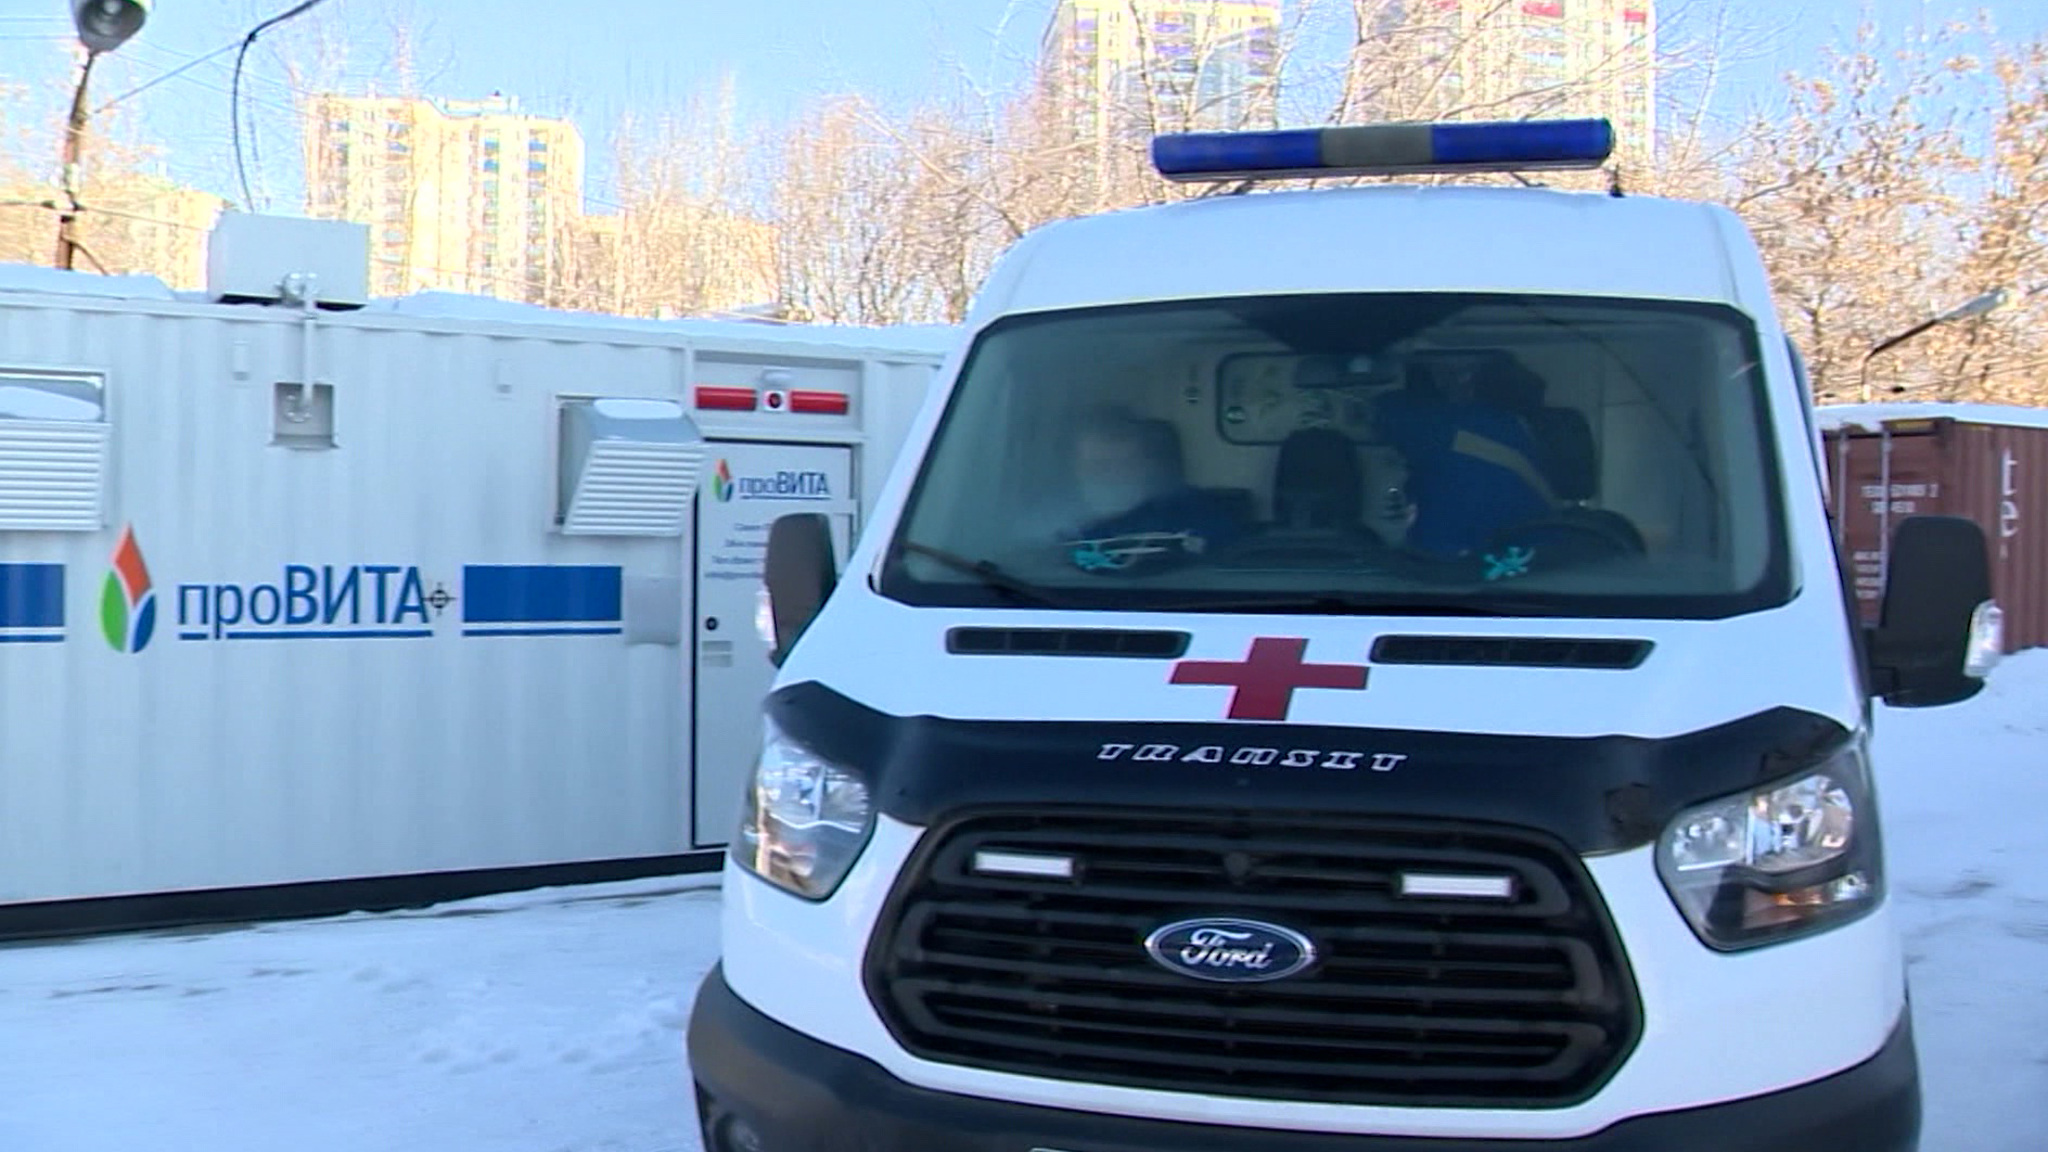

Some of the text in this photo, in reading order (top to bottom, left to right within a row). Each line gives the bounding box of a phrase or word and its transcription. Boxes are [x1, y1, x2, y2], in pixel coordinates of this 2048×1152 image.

[739, 471, 829, 496] проВИТА
[178, 564, 430, 640] проВИТА
[1180, 928, 1274, 969] Ford
